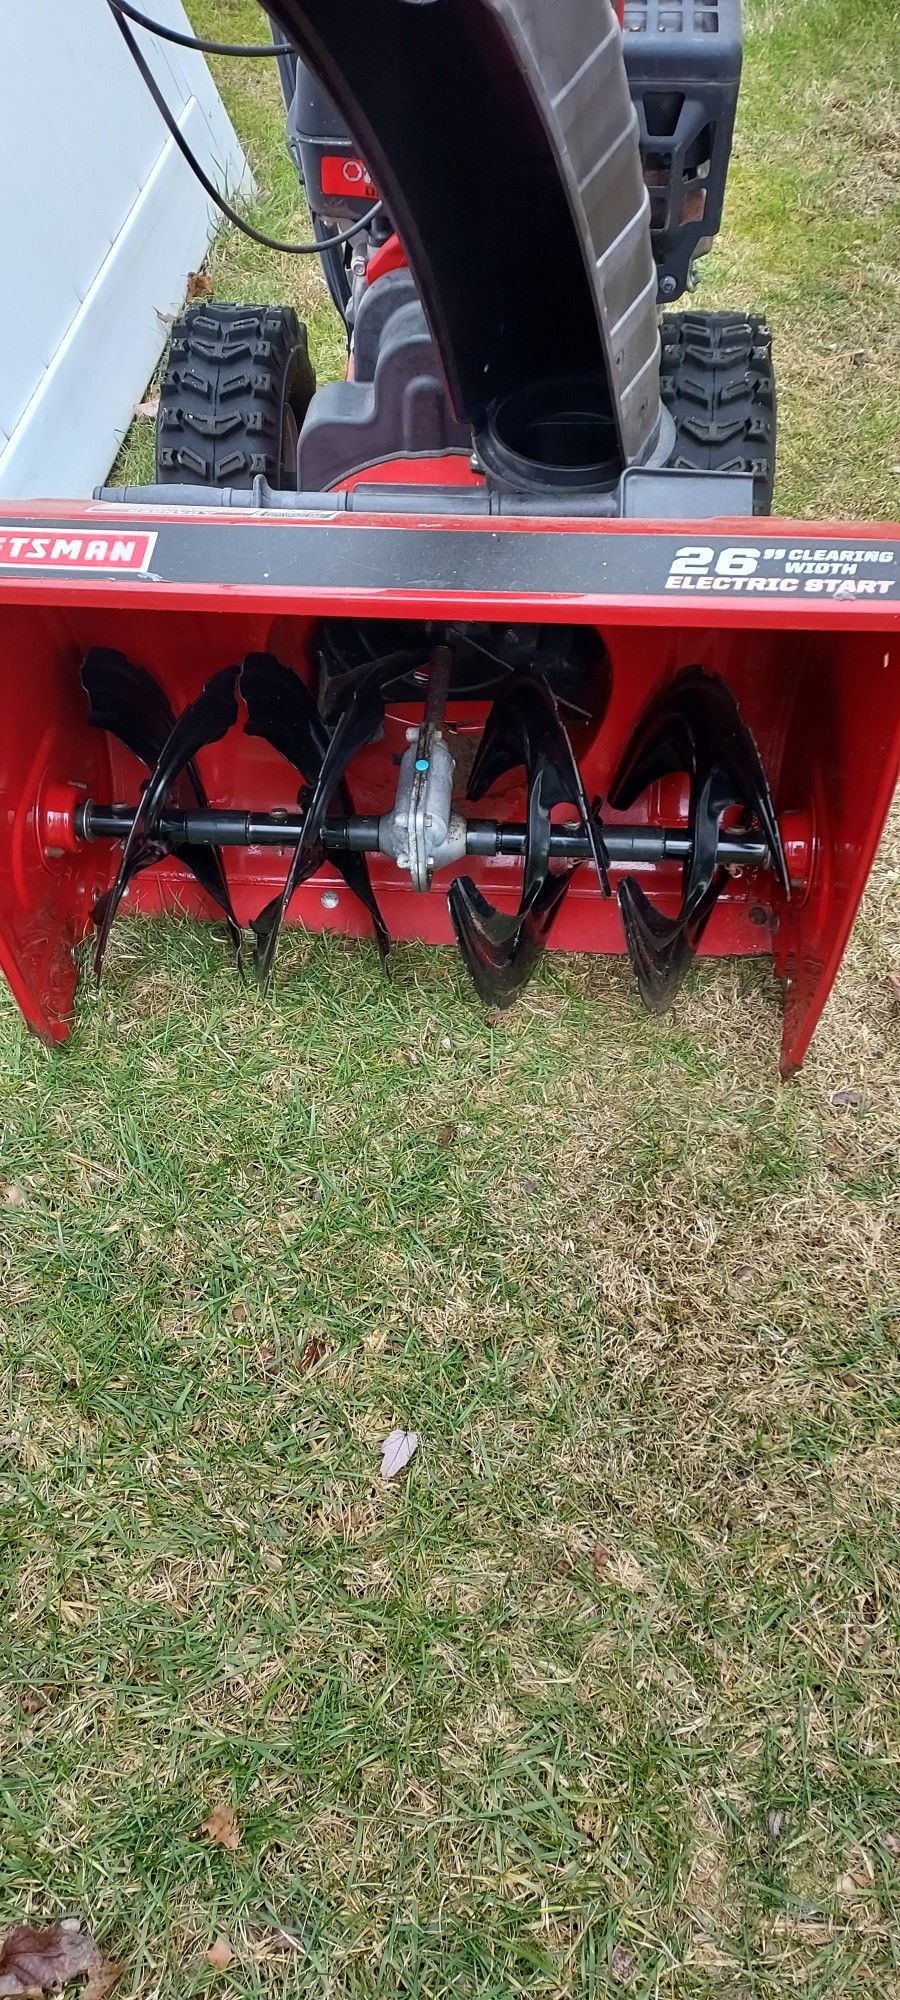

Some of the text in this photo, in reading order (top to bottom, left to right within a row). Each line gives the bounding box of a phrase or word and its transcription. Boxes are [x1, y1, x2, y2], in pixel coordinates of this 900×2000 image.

[788, 549, 894, 563] CLEARING
[785, 562, 857, 575] WIDTH
[665, 576, 895, 594] ELECTRIC START
